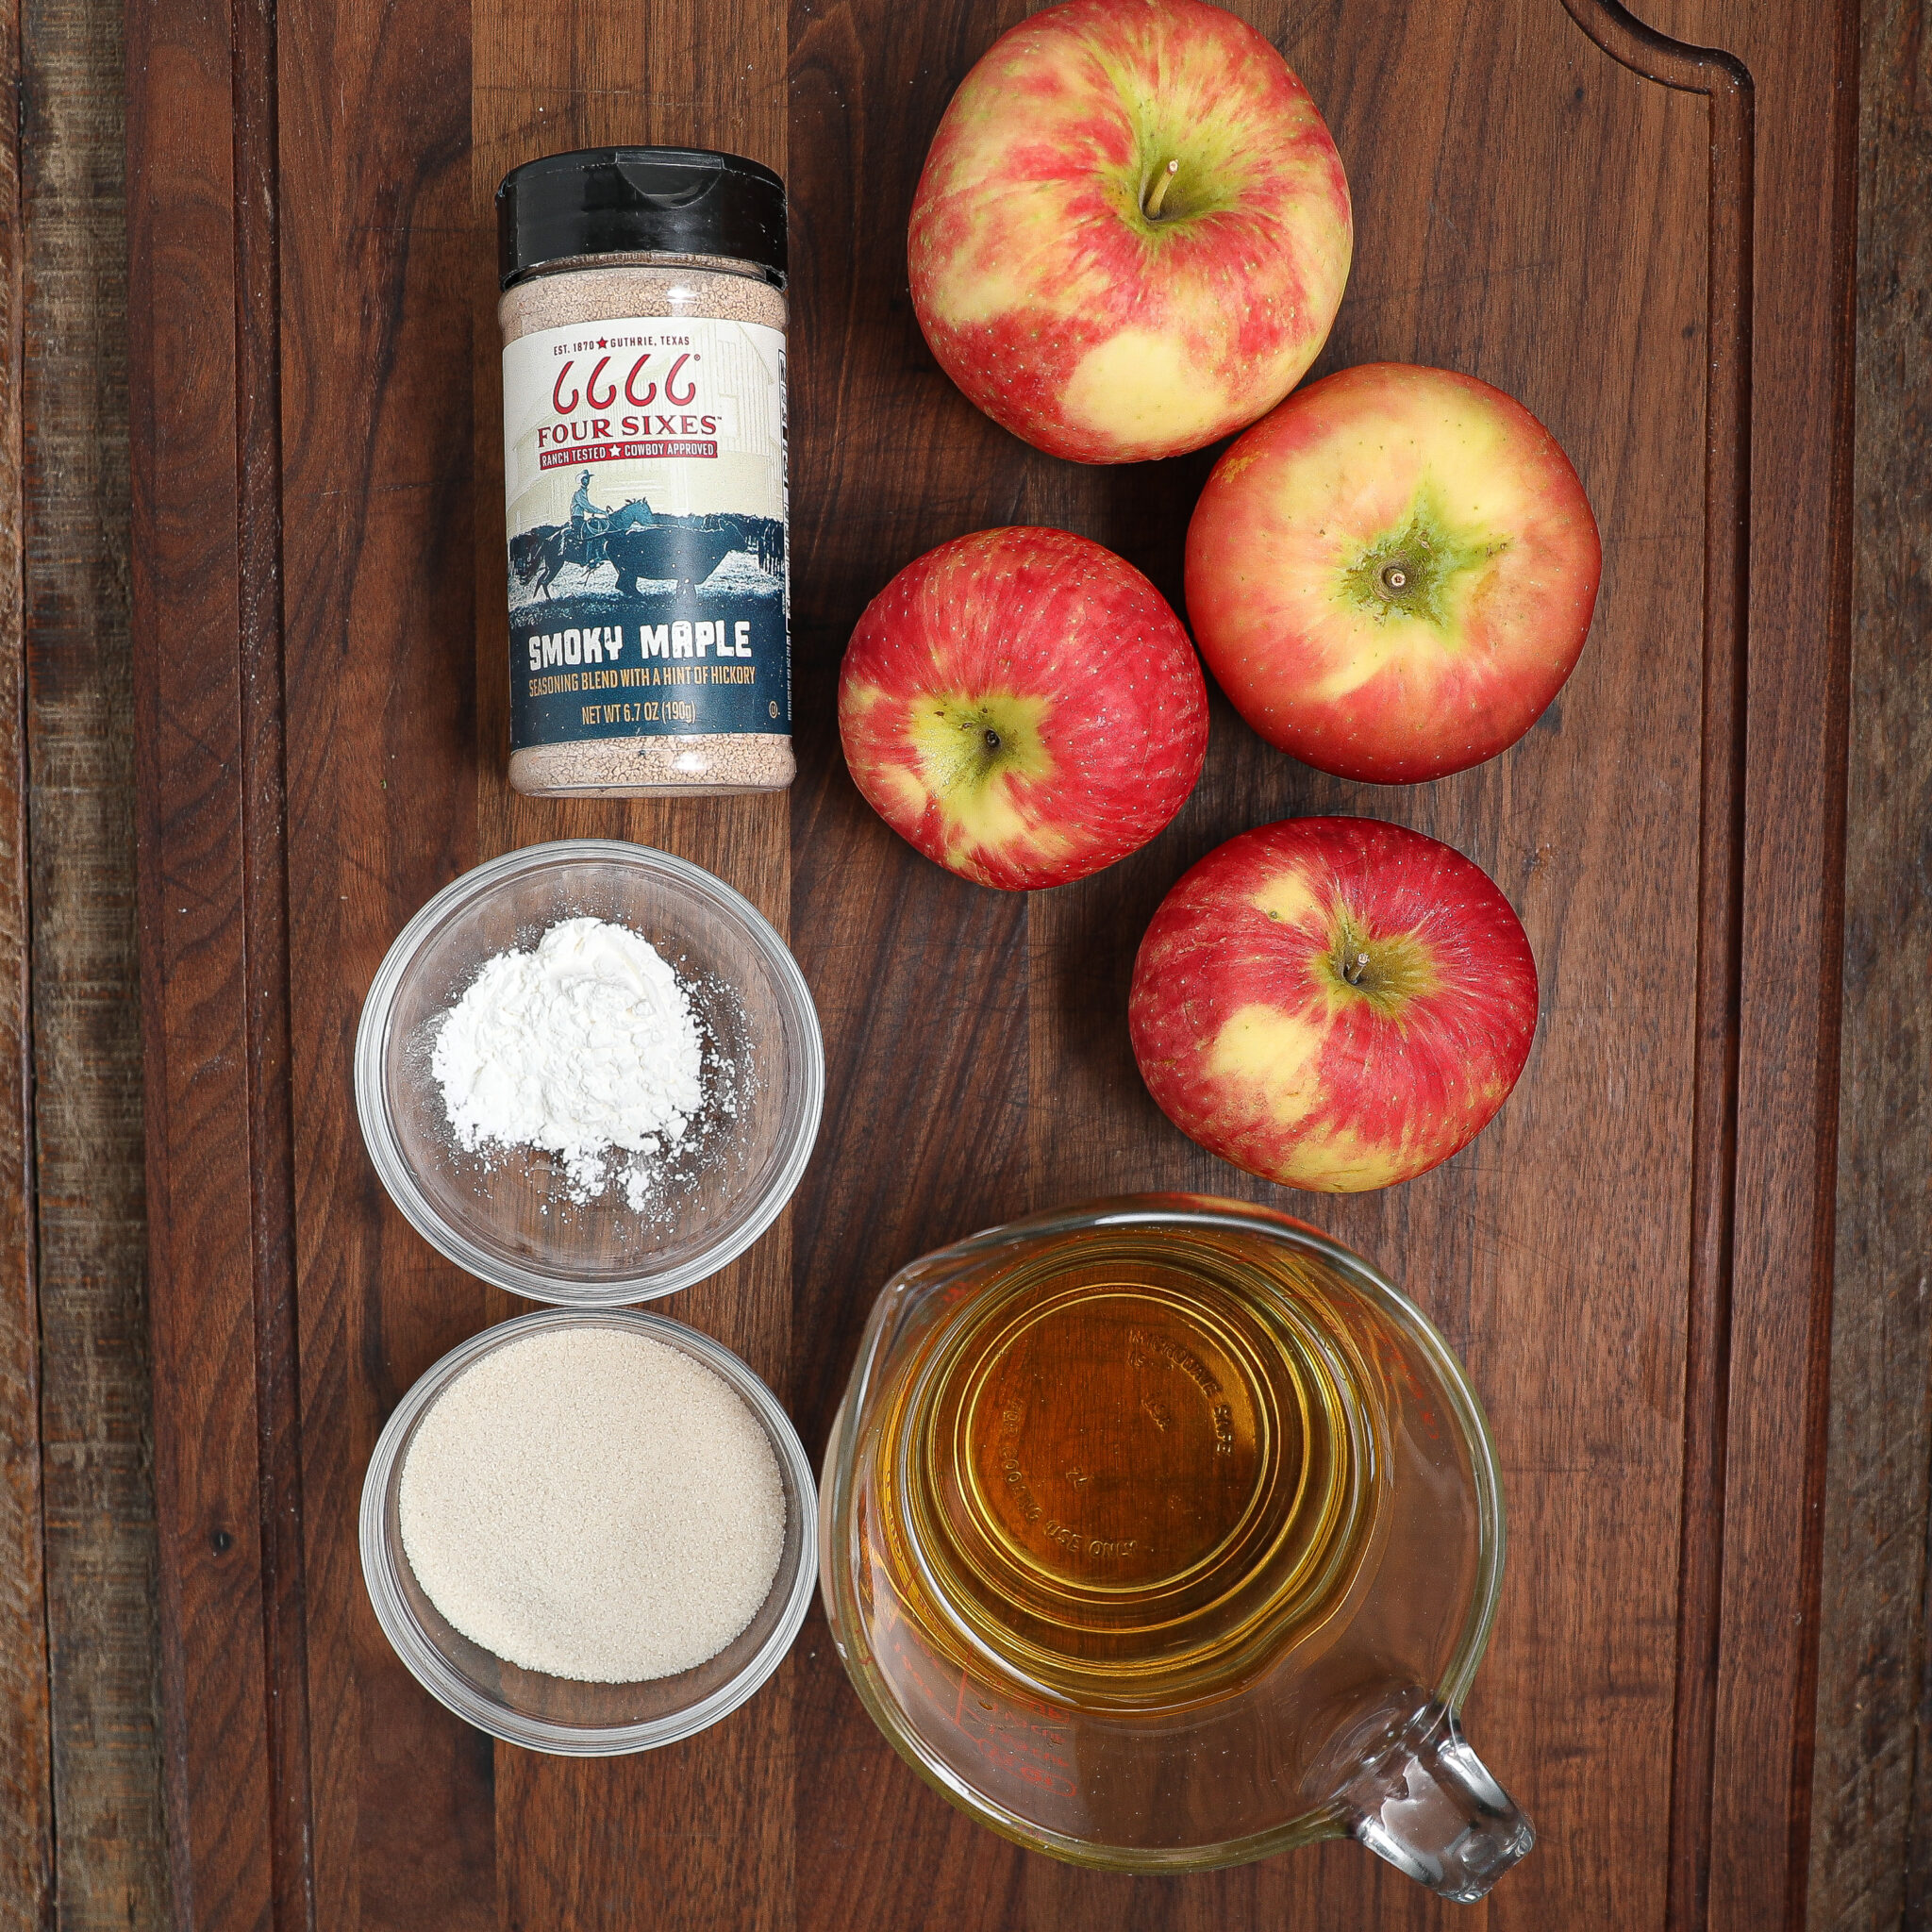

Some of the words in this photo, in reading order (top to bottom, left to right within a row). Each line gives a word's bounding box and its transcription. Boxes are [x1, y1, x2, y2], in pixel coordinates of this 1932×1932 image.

[553, 343, 571, 356] EST.
[573, 341, 595, 353] 1870
[609, 336, 658, 348] GUTHRIE,
[659, 335, 691, 346] TEXAS
[537, 416, 613, 448] FOUR
[541, 450, 570, 467] RANCH
[571, 445, 607, 461] TESTED
[624, 443, 665, 458] COWBOY
[666, 442, 714, 457] APPROVED
[528, 625, 624, 672] SMOKY
[639, 619, 753, 660] MAPLE
[528, 673, 579, 697] SEASONING
[580, 669, 619, 691] BLEND
[620, 667, 653, 688] WITH
[652, 666, 661, 686] A
[662, 666, 692, 685] HINT
[693, 665, 709, 685] OF
[710, 665, 756, 685] HICKORY
[581, 706, 602, 725] NET
[603, 704, 622, 723] WT
[623, 703, 642, 723] 6.7
[643, 701, 660, 722] OZ
[660, 699, 697, 724] (190g)
